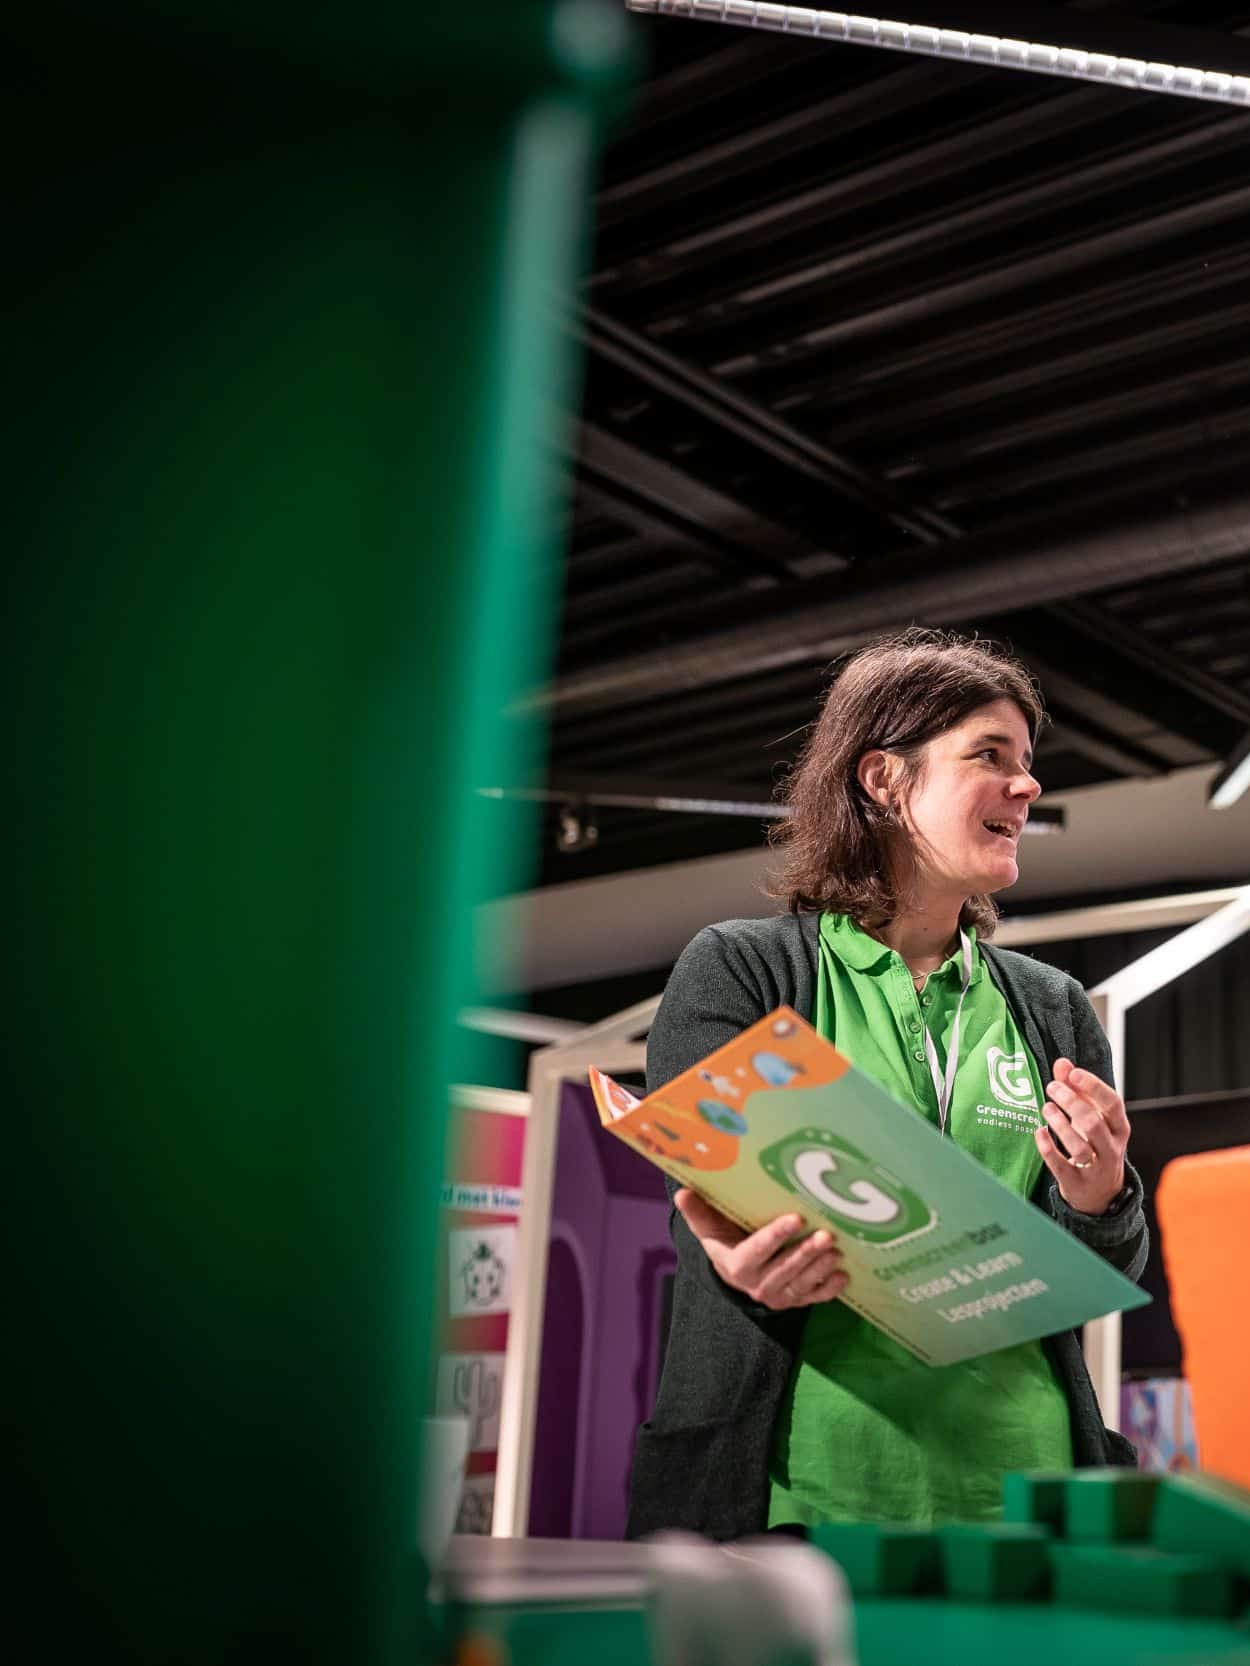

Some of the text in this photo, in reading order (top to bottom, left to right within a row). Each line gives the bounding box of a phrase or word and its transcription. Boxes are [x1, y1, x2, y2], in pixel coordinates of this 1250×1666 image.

[976, 1104, 1042, 1126] Greenscree
[977, 1117, 1012, 1129] endless
[900, 1275, 958, 1304] Create
[963, 1251, 1023, 1281] Learn
